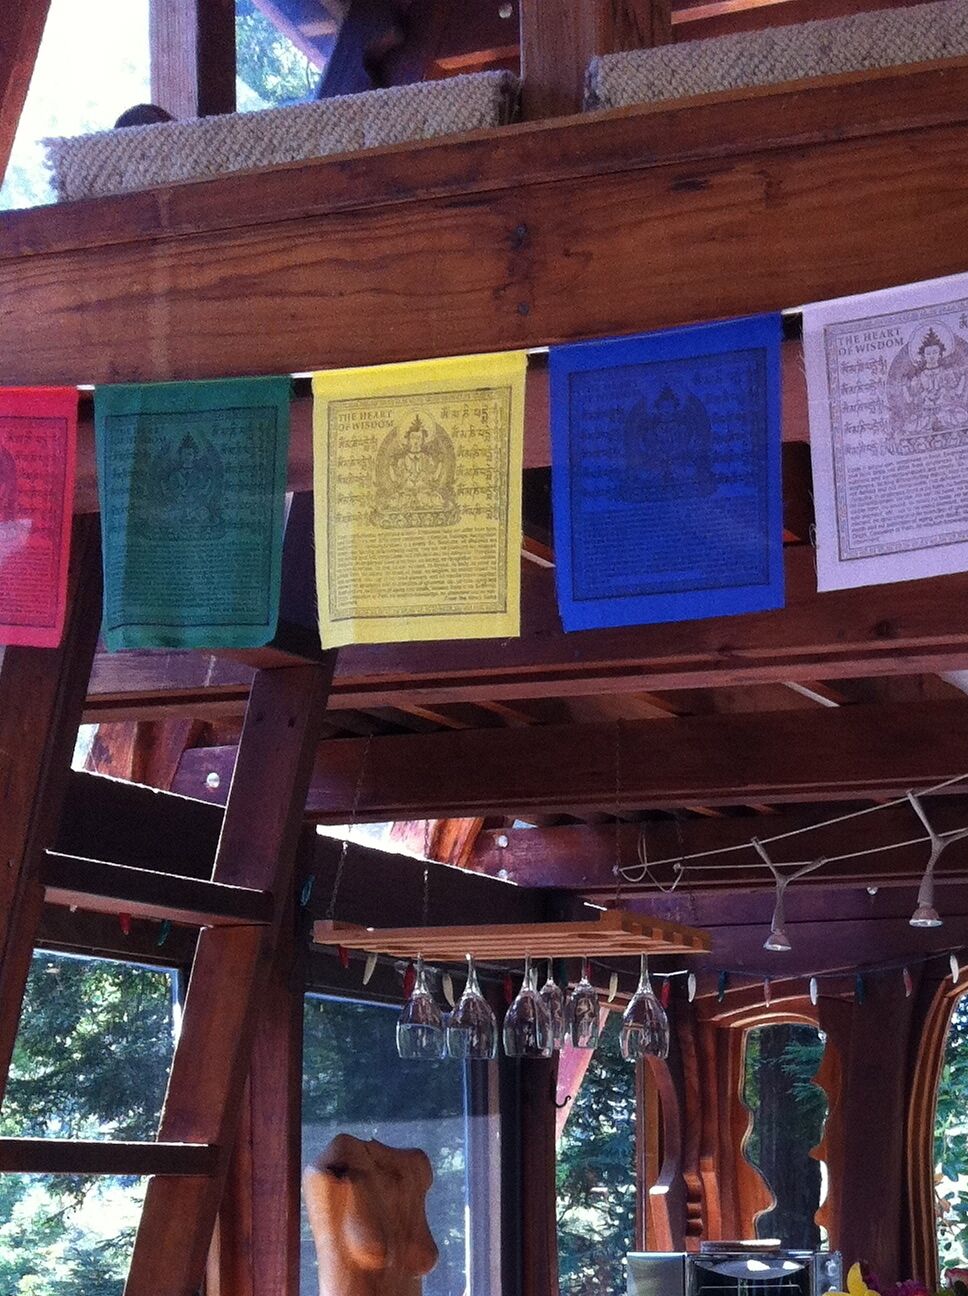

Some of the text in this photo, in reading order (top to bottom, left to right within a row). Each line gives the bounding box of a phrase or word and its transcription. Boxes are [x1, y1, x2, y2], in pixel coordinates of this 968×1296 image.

[837, 328, 900, 346] THE HEART
[838, 337, 904, 356] OF WISDOM
